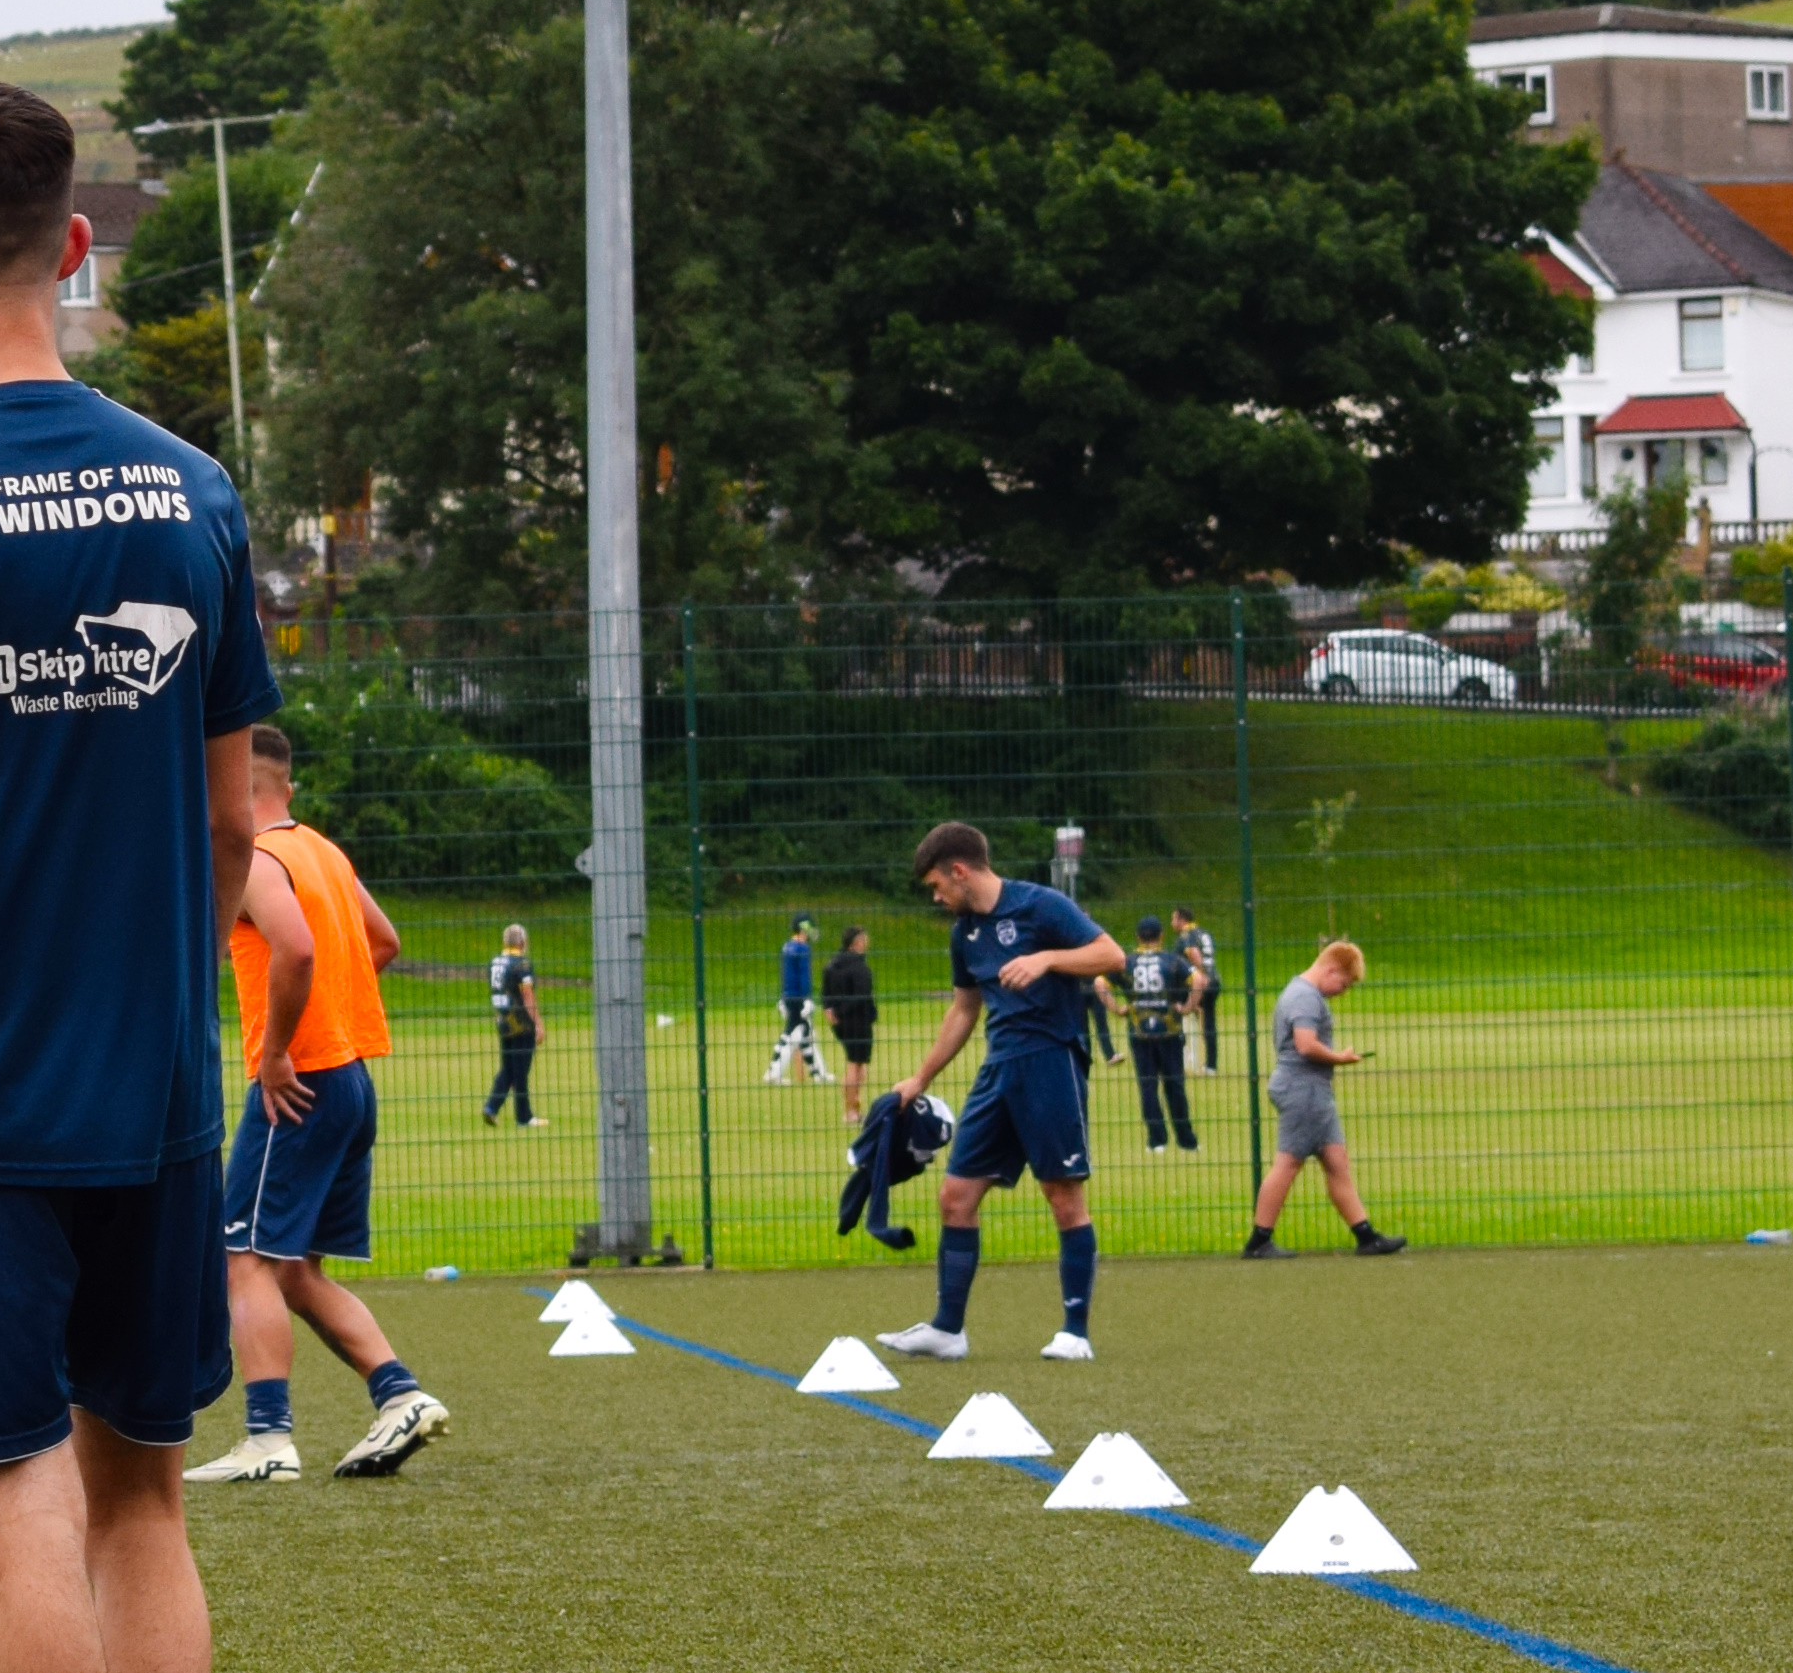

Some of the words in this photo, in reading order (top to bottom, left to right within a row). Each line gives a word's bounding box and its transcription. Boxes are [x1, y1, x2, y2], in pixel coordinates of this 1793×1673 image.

[79, 468, 113, 490] OF
[120, 465, 181, 486] MIND
[19, 648, 85, 686] Skip
[91, 642, 151, 675] hire
[11, 693, 59, 715] Waste
[63, 687, 139, 712] Recycling
